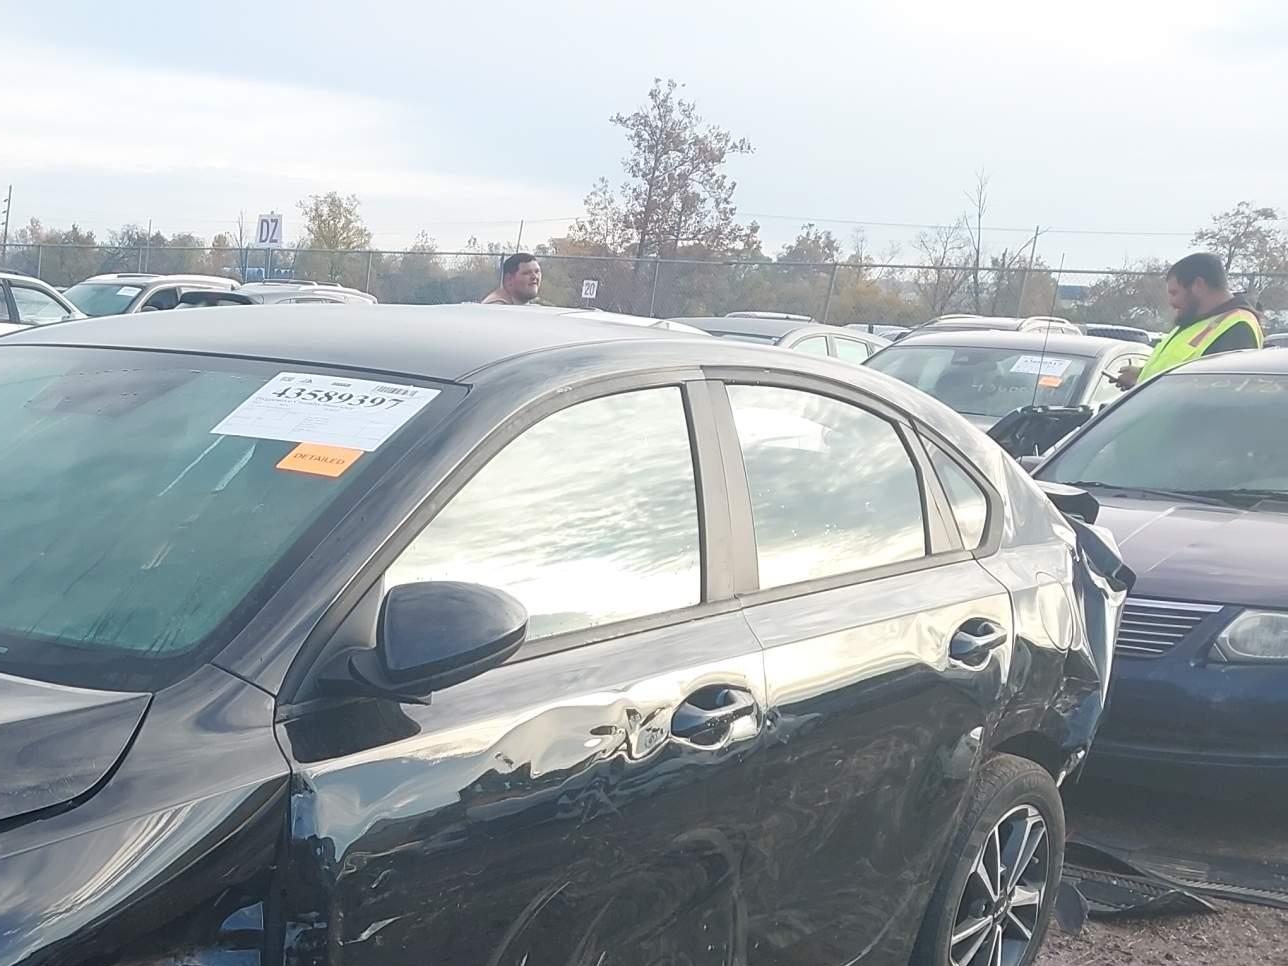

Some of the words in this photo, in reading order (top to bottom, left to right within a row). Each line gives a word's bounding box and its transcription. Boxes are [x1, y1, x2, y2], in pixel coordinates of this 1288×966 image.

[584, 282, 596, 297] 20
[271, 385, 405, 411] 43589397
[293, 452, 346, 466] DETAILED
